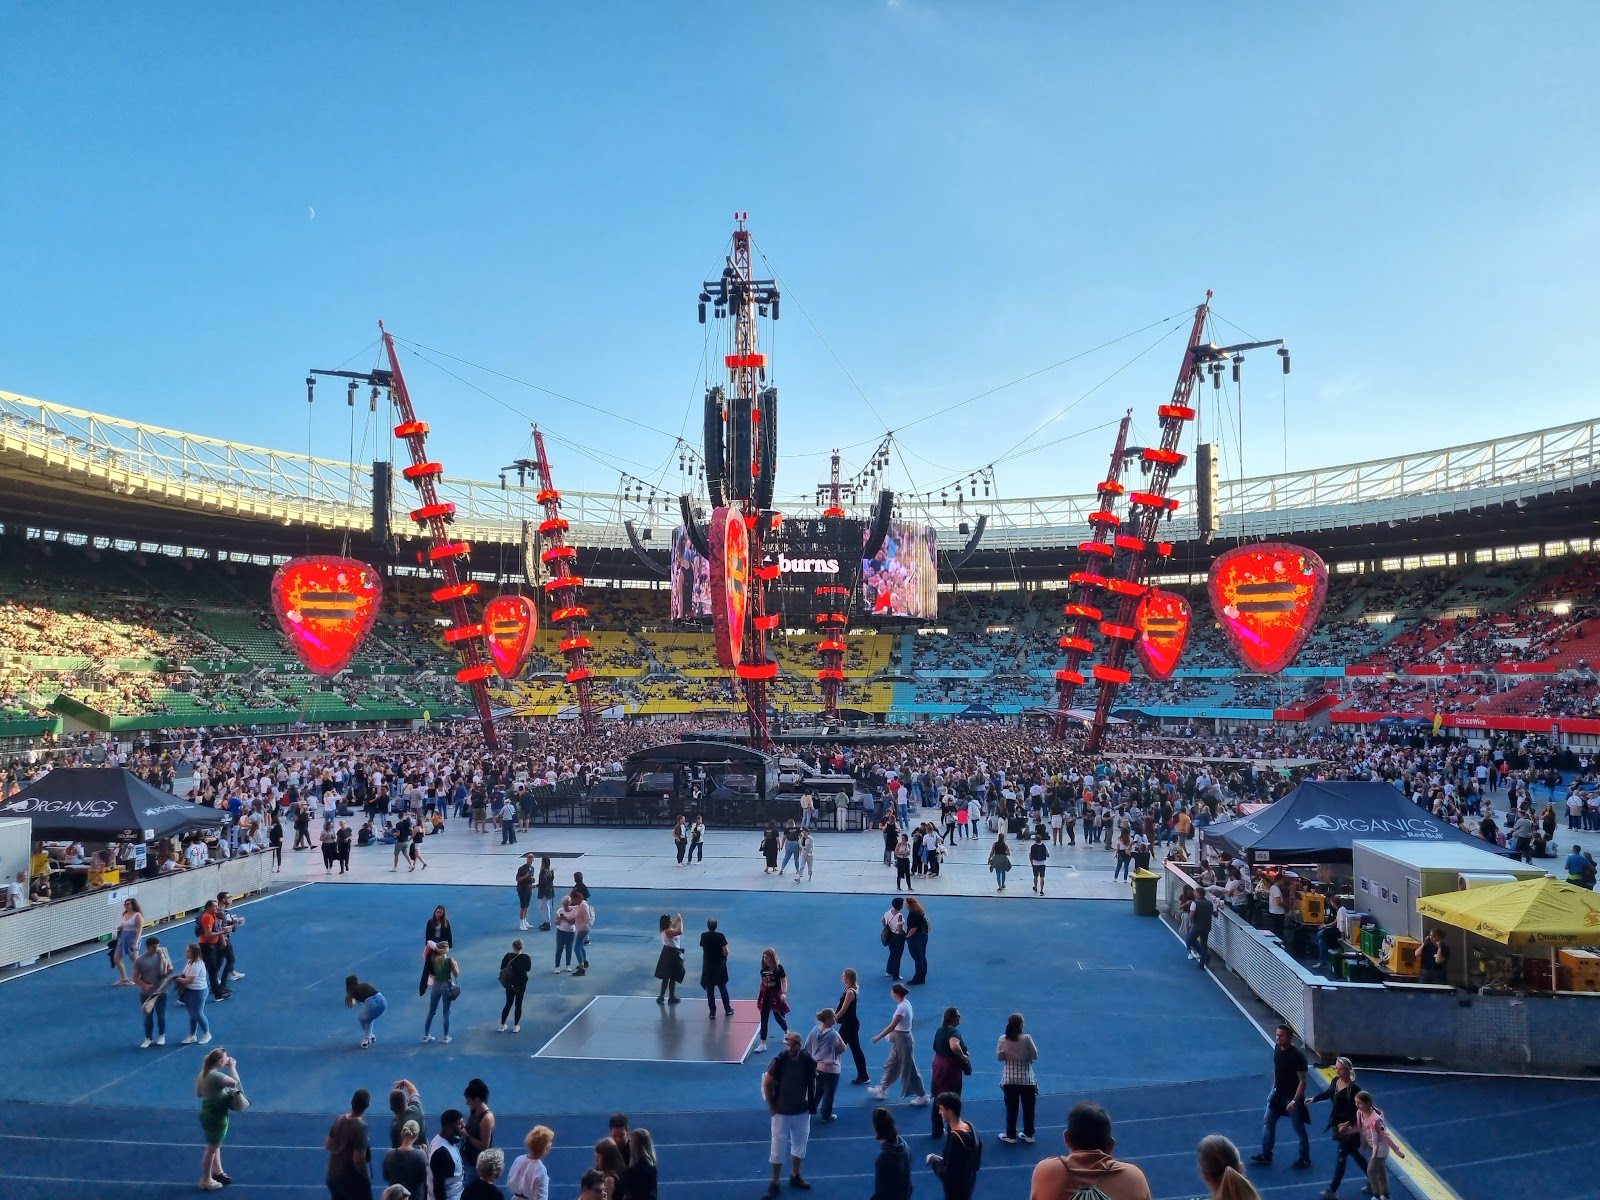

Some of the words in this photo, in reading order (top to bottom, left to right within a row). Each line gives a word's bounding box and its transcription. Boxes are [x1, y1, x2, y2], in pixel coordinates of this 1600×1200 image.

[778, 553, 840, 573] burns
[14, 798, 118, 812] ORGANICS
[1314, 814, 1438, 832] ORGANICS
